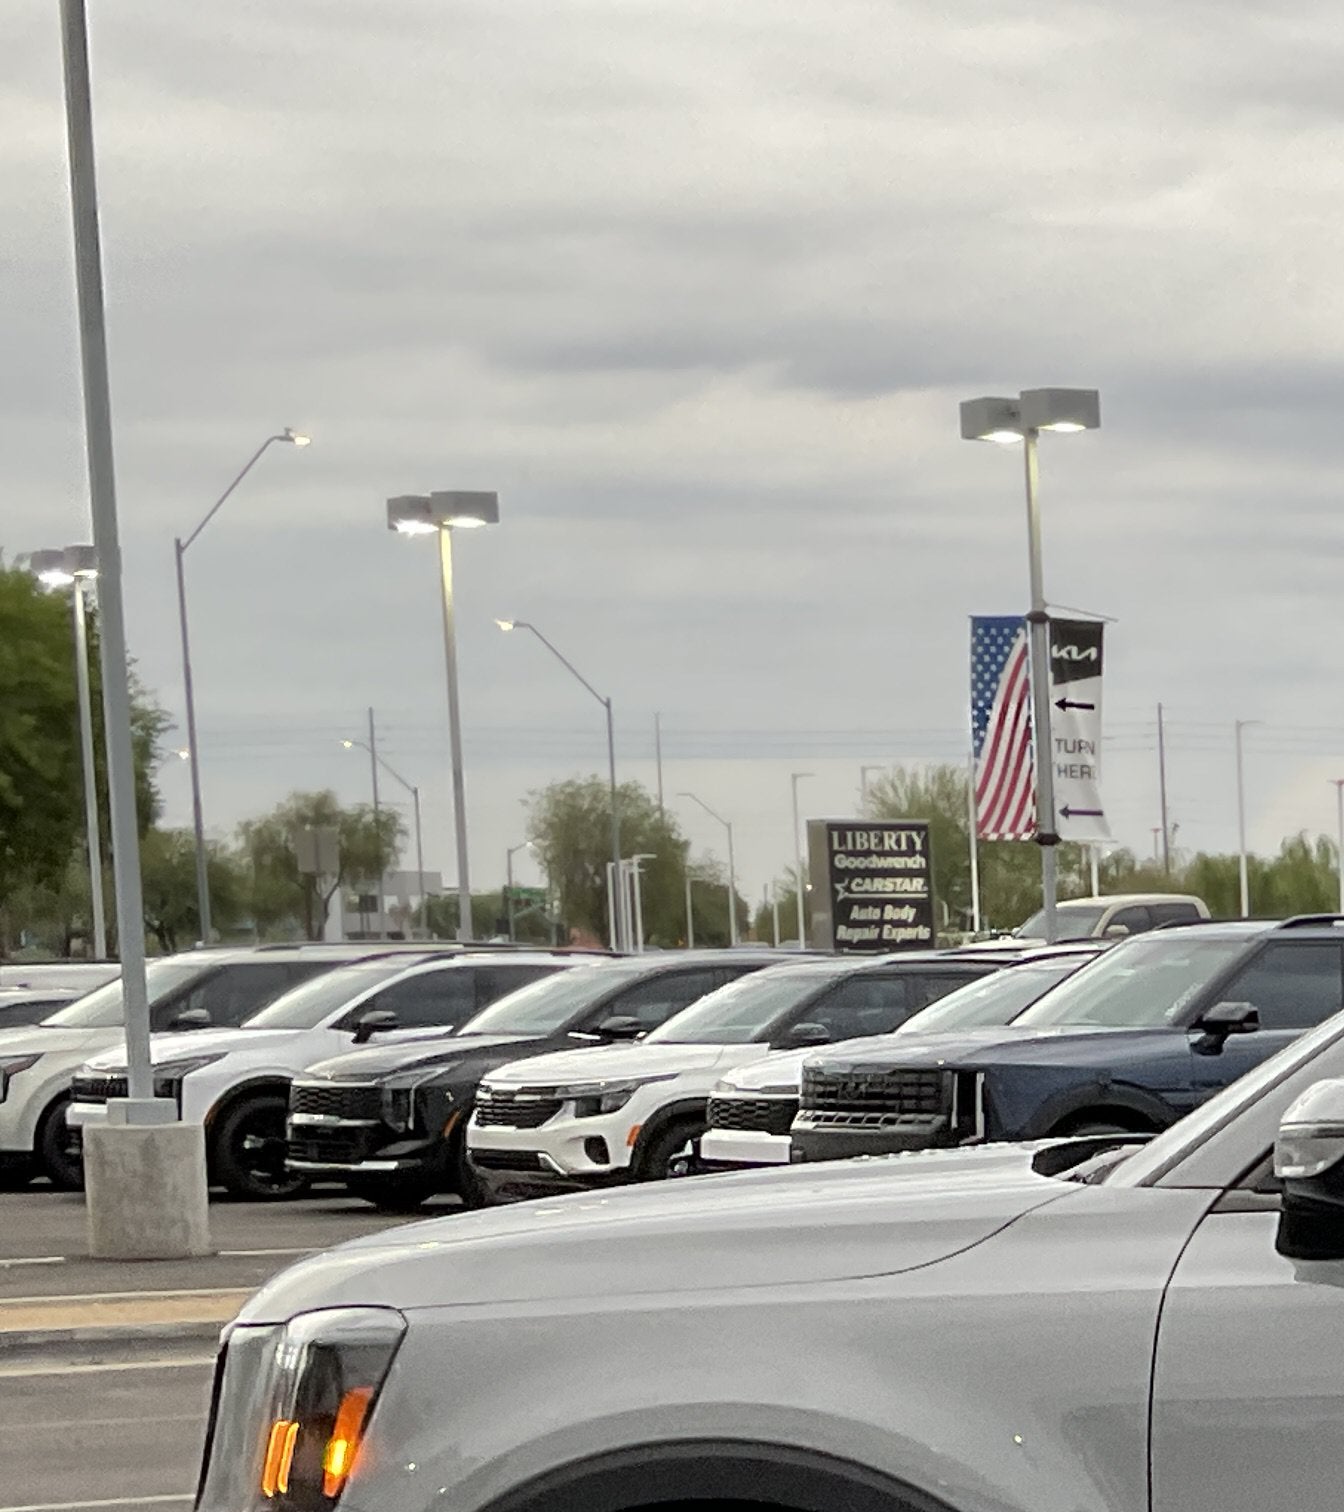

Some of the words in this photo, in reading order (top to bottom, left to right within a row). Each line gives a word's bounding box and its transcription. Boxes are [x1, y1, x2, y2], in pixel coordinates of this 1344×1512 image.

[1054, 737, 1096, 755] TURN
[831, 830, 926, 851] LIBERTY
[834, 853, 927, 869] Goodwrench
[850, 877, 926, 892] CARSTAR
[850, 904, 881, 920] Auto
[882, 904, 917, 923] Body
[836, 924, 880, 943] Repair
[882, 924, 931, 943] Experts
